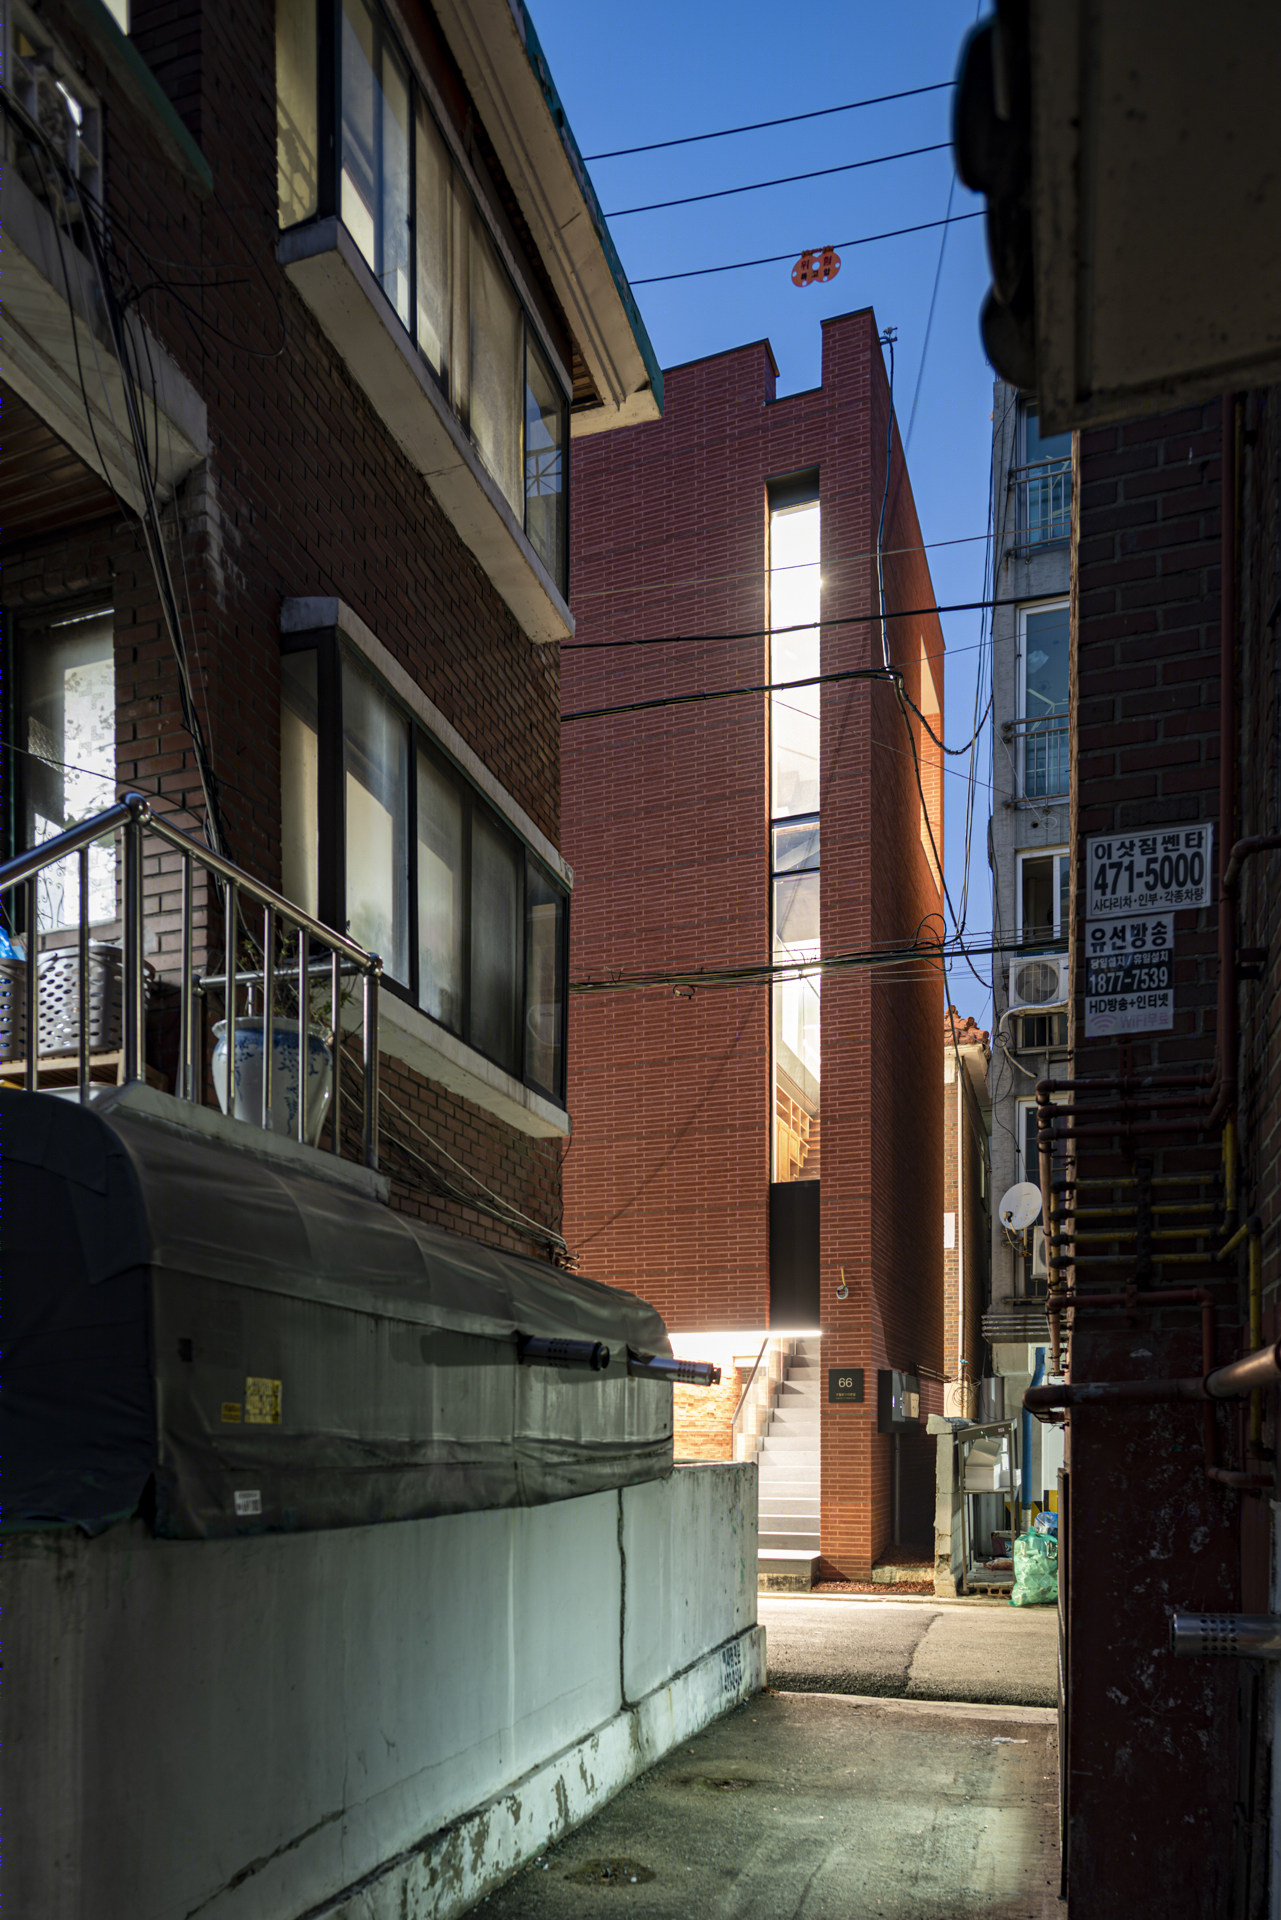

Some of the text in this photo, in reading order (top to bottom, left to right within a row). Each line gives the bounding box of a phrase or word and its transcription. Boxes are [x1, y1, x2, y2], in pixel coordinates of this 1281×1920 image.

[1094, 851, 1204, 896] 471-5000
[1090, 921, 1168, 954] 유선방송
[1133, 950, 1168, 965] 휴일설치
[1090, 967, 1168, 994] 1877-7539
[838, 1377, 853, 1388] 66
